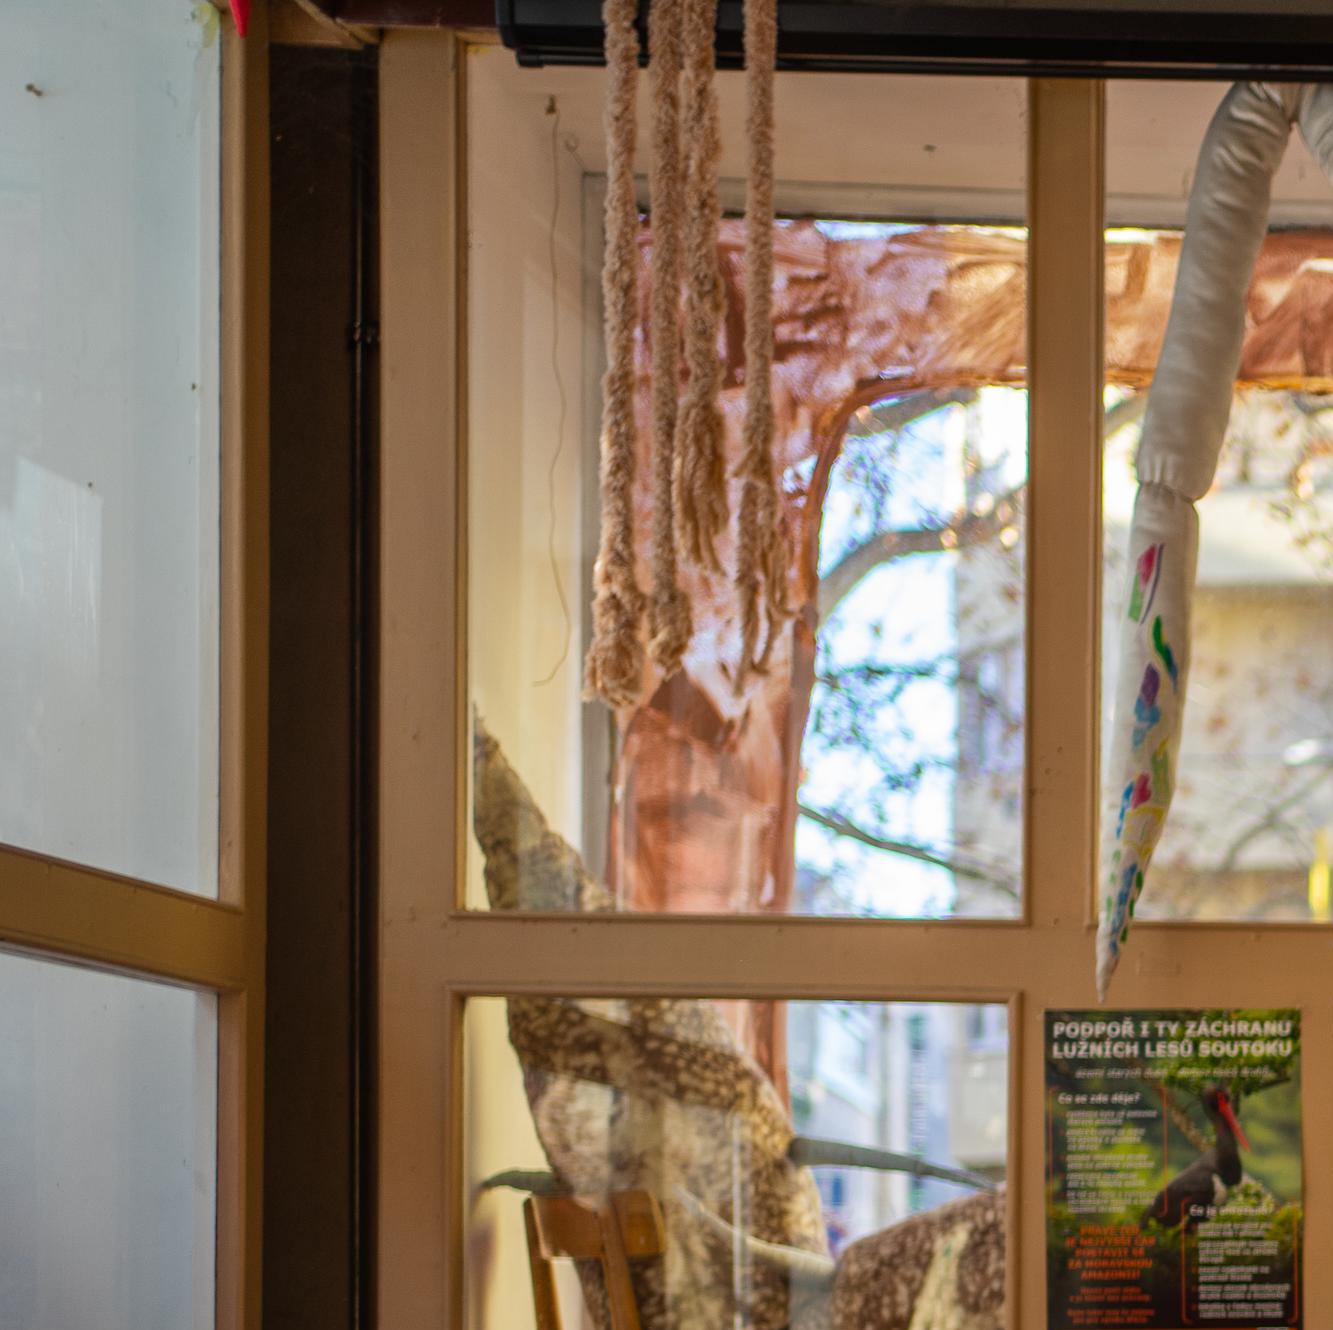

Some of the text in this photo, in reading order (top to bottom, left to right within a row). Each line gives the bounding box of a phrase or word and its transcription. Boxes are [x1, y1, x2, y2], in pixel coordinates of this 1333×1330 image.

[1053, 1017, 1292, 1038] PODPOŘ I TY ZÁCHRANU
[1052, 1038, 1293, 1058] LUŽNÍCH LESŮ SOUTOKU
